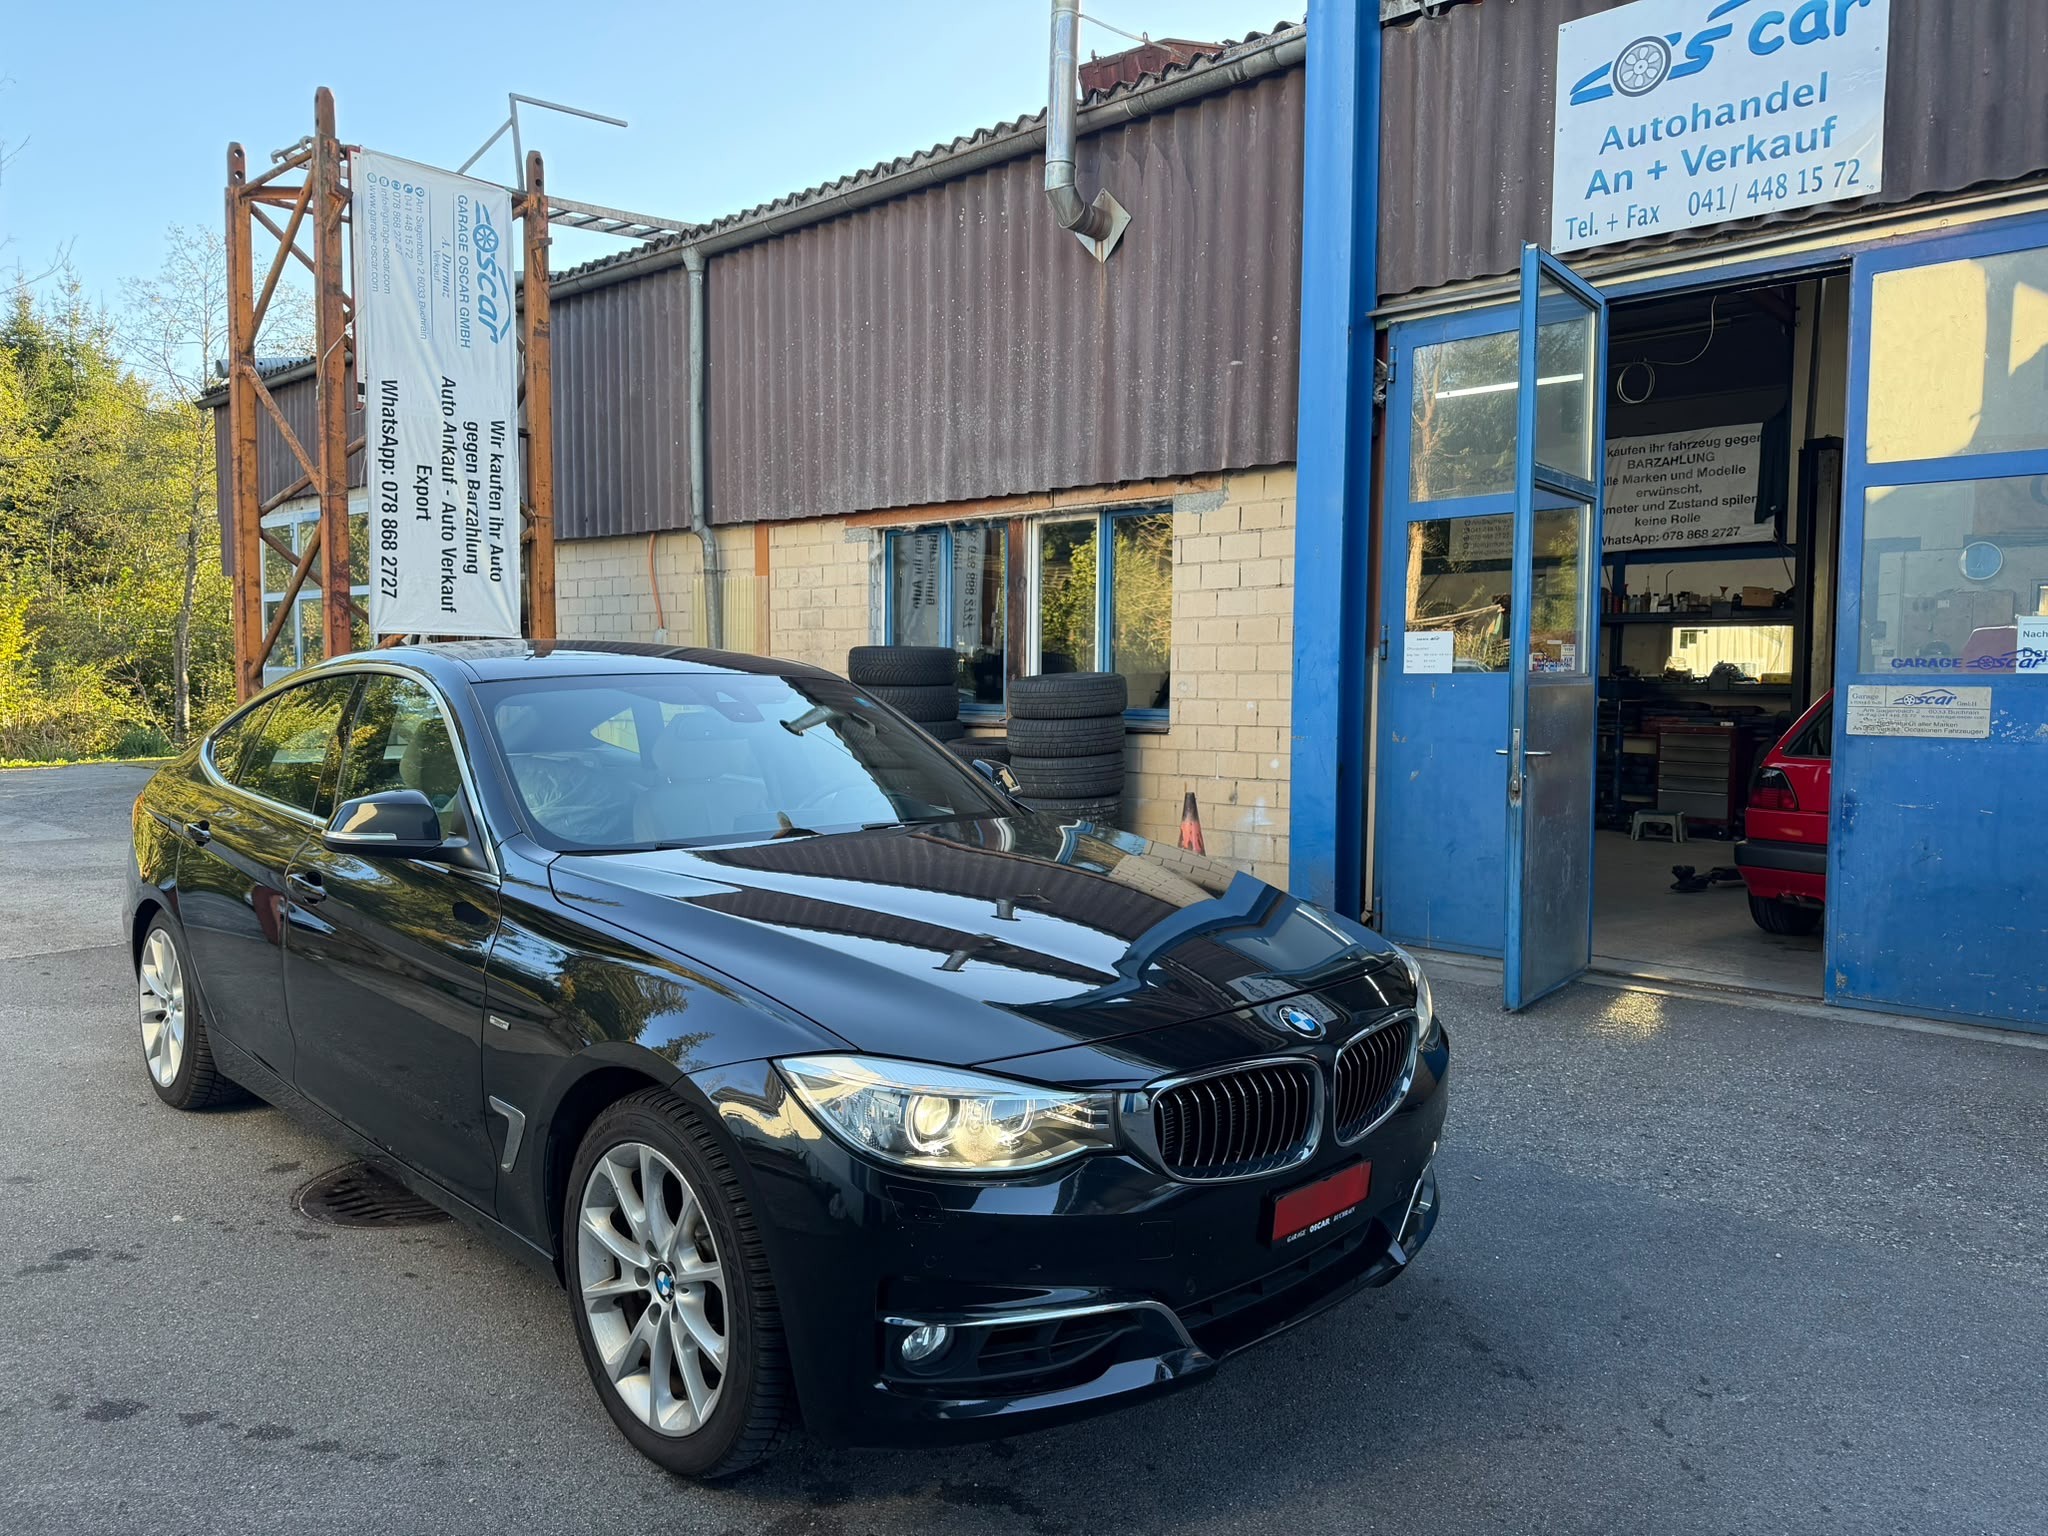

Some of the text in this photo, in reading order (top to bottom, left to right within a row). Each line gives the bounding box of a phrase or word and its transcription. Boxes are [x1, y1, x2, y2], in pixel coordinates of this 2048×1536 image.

[1599, 71, 1829, 155] Autohandel
[1584, 115, 1838, 200] An + Verkauf
[392, 192, 401, 212] 078
[415, 197, 424, 213] Am
[1565, 216, 1599, 241] Tel.
[1606, 212, 1619, 233] +
[1627, 203, 1660, 229] Fax
[1747, 173, 1788, 204] 448
[1797, 166, 1823, 195] 15
[1834, 158, 1860, 188] 72
[368, 184, 379, 293] www.garage-oscar.com
[393, 212, 401, 230] 868
[403, 195, 414, 260] 041 448 15 72
[414, 216, 425, 266] Sagenbach
[432, 249, 441, 282] Verkauf
[441, 252, 452, 299] Durmaz
[457, 194, 471, 349] GARAGE OSCAR GMBH
[416, 275, 426, 303] 6033
[417, 302, 427, 340] Buchrain
[441, 375, 457, 417] Auto
[441, 420, 458, 485] Ankauf
[1607, 445, 1646, 458] kaufen
[1649, 442, 1665, 454] ihr
[1668, 436, 1721, 451] fahrzeug
[1627, 452, 1716, 470] BARZAHLUNG
[377, 380, 399, 599] WhatsApp: 078 868 2727
[412, 464, 432, 522] Export
[1622, 474, 1667, 485] Marken
[1670, 470, 1693, 482] und
[1697, 465, 1746, 478] Modelle
[462, 421, 482, 575] gegen Barzahlung
[488, 420, 505, 583] Wir kaufen ihr Auto
[1642, 500, 1665, 511] und
[1668, 497, 1719, 511] Zustand
[441, 501, 457, 541] Auto
[1634, 512, 1701, 527] keine Rolle
[1662, 530, 1684, 541] 078
[1687, 529, 1709, 540] 868
[1712, 526, 1741, 538] 2727
[440, 547, 457, 613] Verkauf
[1891, 657, 1963, 669] GARAGE
[1851, 692, 1879, 701] Garage
[1943, 728, 1984, 736] Fahrzeugen
[1309, 1218, 1330, 1233] OSCAR
